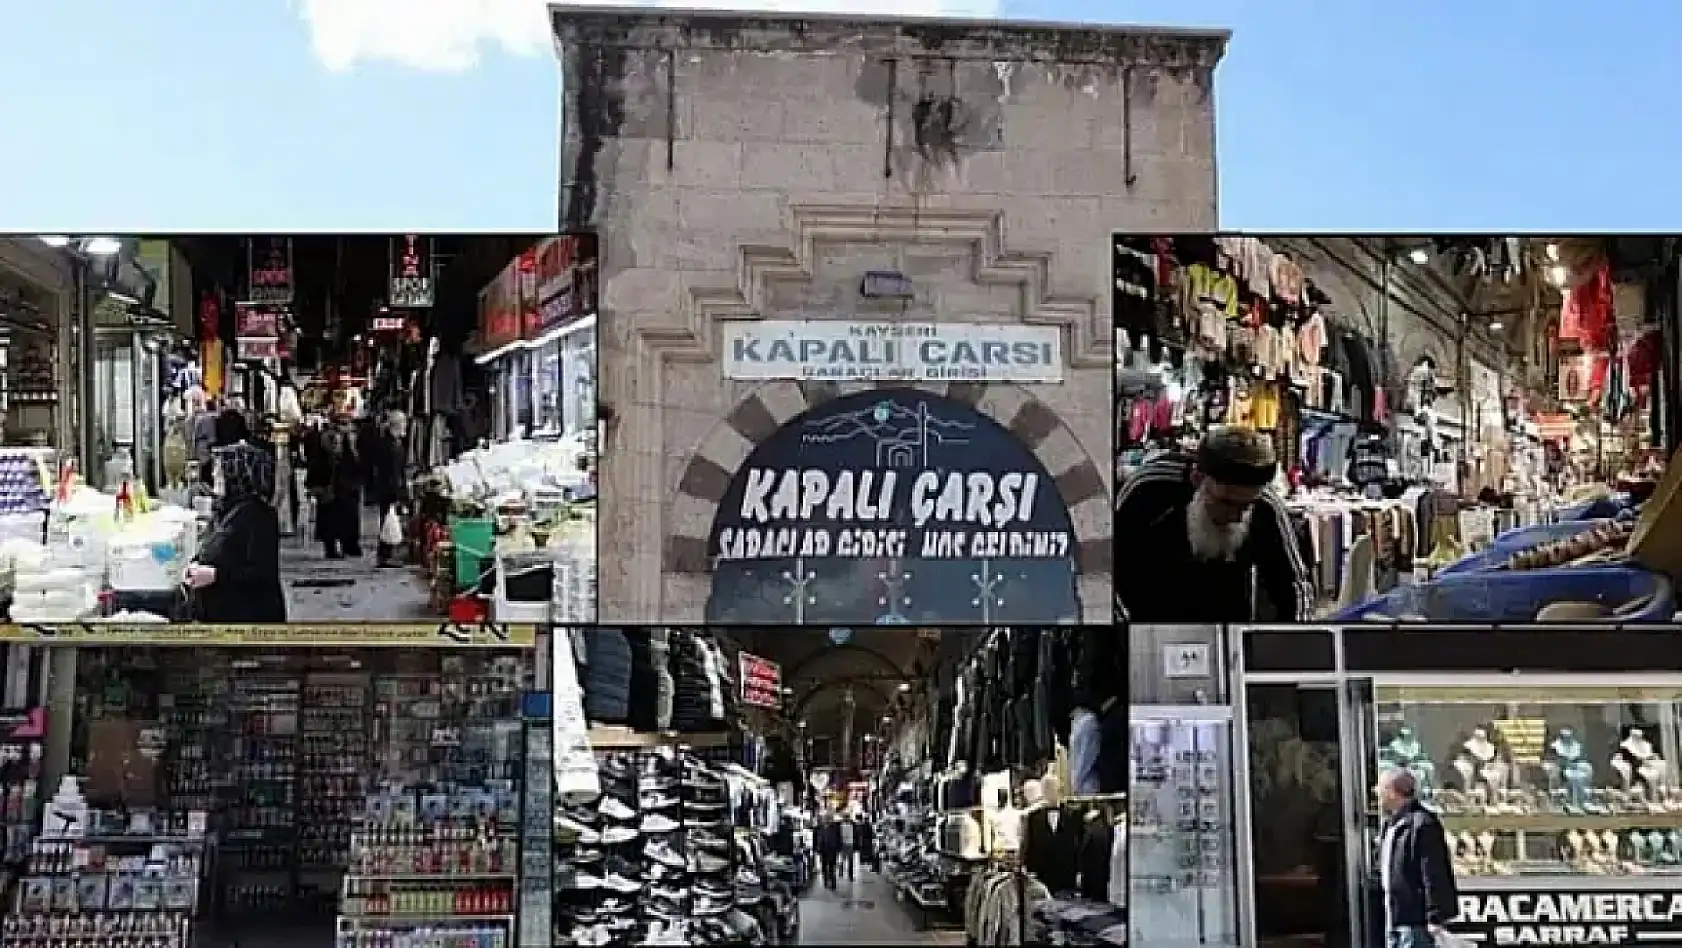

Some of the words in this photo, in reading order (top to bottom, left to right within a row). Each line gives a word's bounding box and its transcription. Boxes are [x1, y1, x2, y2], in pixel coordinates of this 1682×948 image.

[733, 338, 894, 363] KAPALI
[741, 469, 897, 523] KAPALI
[912, 471, 1039, 528] ÇARŞI
[1494, 925, 1629, 946] SARRAF
